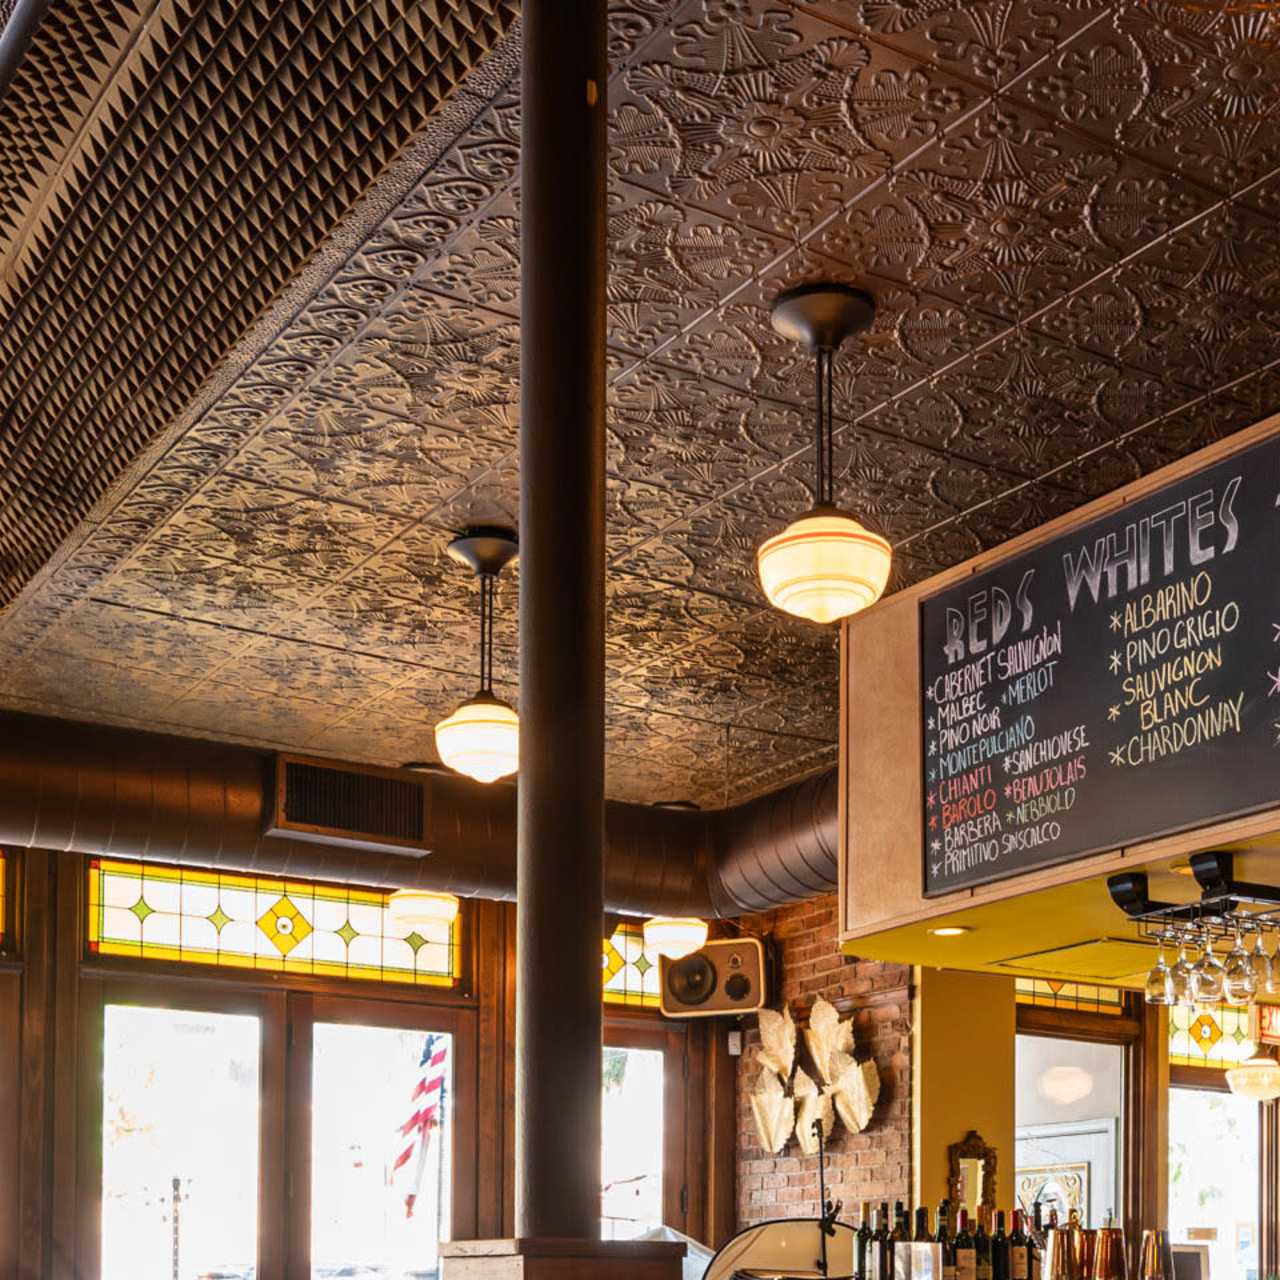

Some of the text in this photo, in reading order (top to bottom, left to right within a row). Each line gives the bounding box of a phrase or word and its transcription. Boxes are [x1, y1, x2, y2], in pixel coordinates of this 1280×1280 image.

[1061, 475, 1243, 613] WHITES
[943, 568, 1036, 665] REDS
[1122, 570, 1212, 638] ALBARINO
[933, 619, 1062, 704] CABERNET SAUVIGNON
[1125, 600, 1241, 673] PINO GRIGIO
[1008, 660, 1059, 707] MERLOT
[1122, 644, 1223, 706] SAUVIGNON
[937, 690, 987, 731] MALBEC
[938, 706, 1001, 755] PINO NOIR
[1126, 690, 1245, 766] CHARDONNAY
[1139, 676, 1211, 732] BLANC
[938, 763, 992, 805] CHIANTI
[1011, 754, 1088, 804] BEAUJOLAIS
[941, 788, 997, 830] BAROLO
[943, 810, 1003, 852] BARBERA
